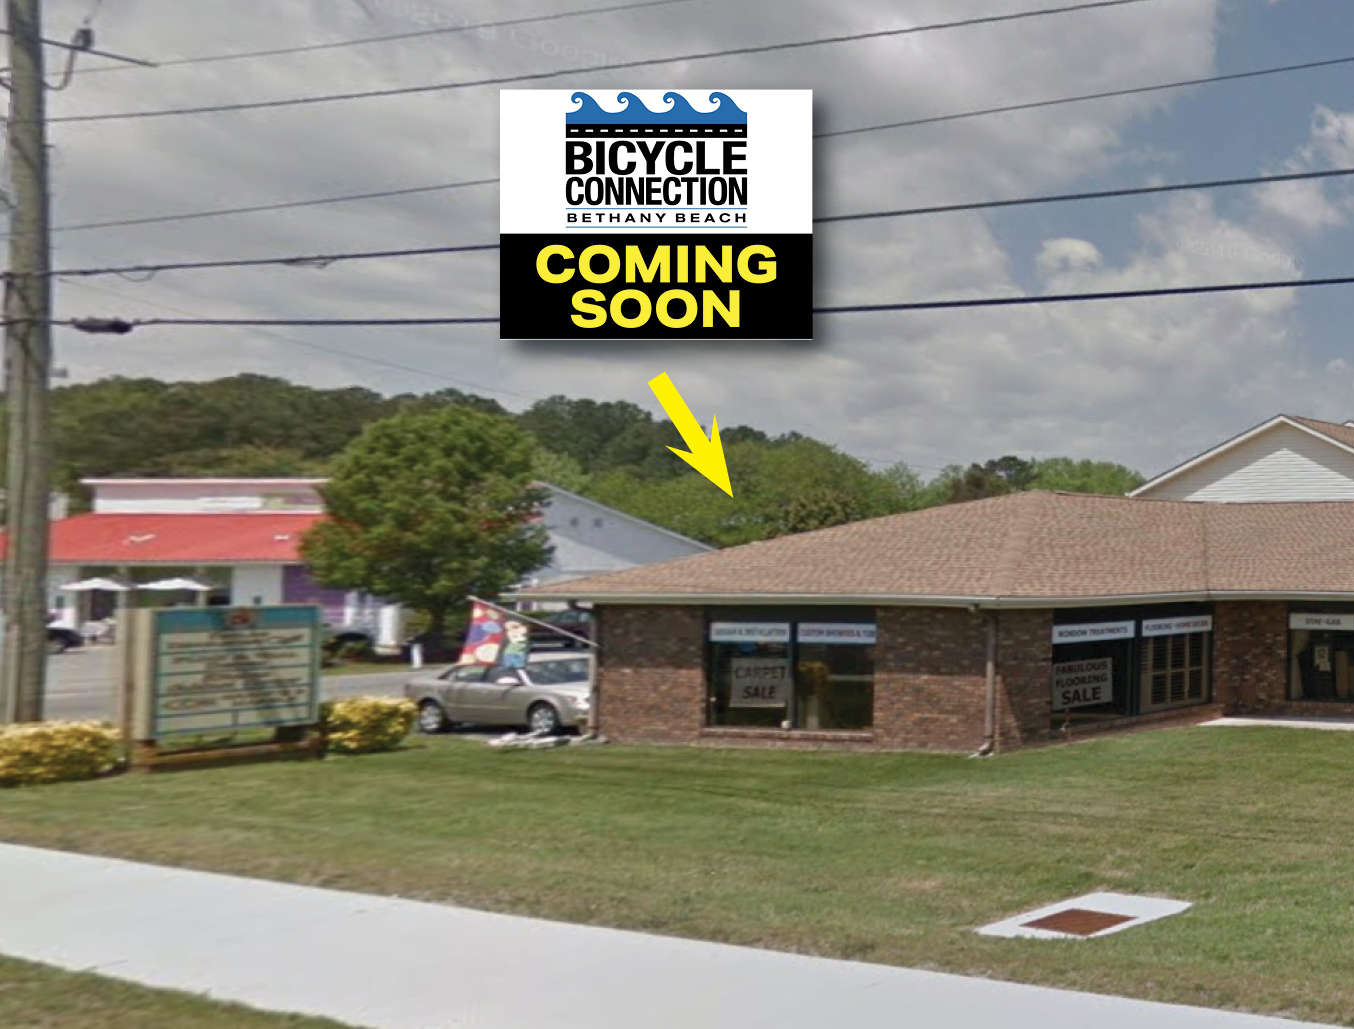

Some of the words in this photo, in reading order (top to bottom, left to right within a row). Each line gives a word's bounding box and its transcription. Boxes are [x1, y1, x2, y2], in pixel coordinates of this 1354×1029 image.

[736, 666, 785, 679] CARPET
[1055, 660, 1108, 674] FABULOUS
[1055, 673, 1108, 687] FLOORING
[744, 686, 776, 699] SALE
[1062, 687, 1101, 705] SALE
